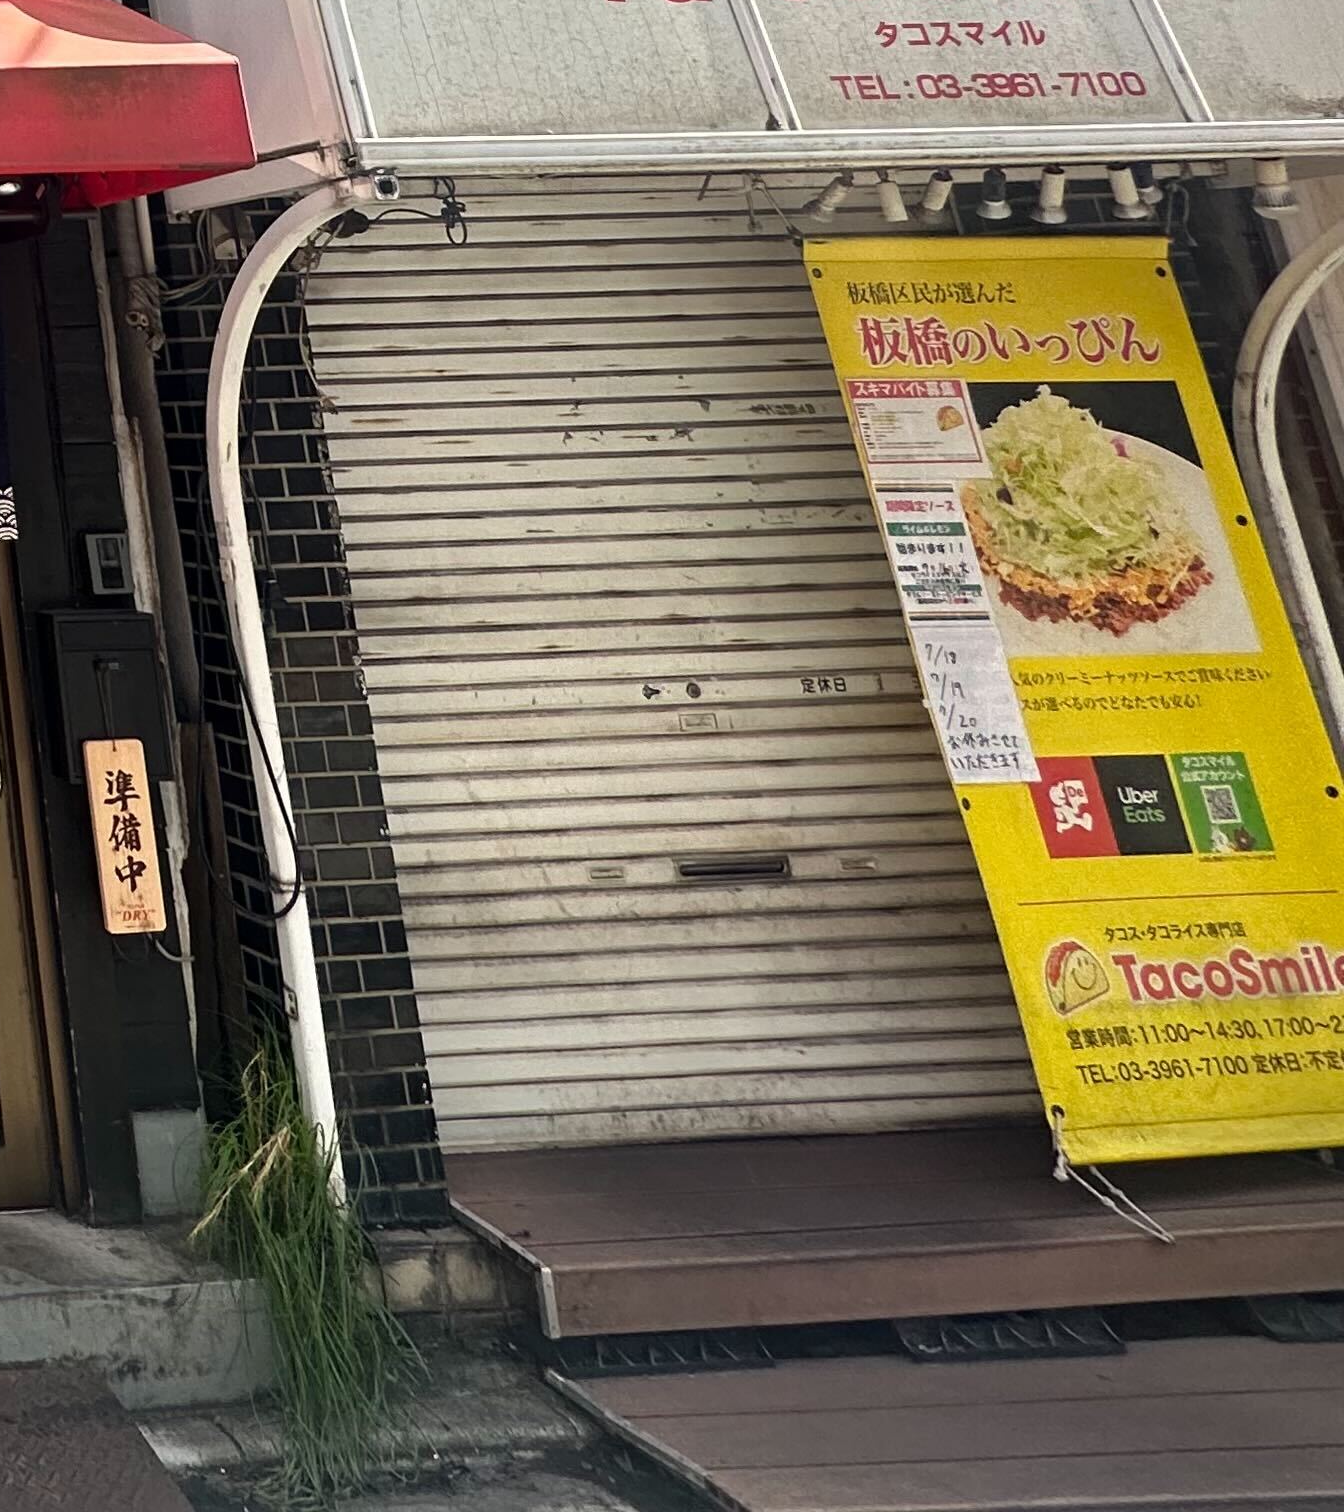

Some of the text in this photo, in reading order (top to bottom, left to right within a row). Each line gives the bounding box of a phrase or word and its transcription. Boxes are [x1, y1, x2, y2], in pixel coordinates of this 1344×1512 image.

[875, 21, 1046, 48] タコスマイル
[847, 281, 1017, 306] 板橋区民が選んだ
[857, 315, 1161, 367] 板橋のいっぴん
[855, 381, 957, 398] スキマバイト募集
[800, 677, 847, 694] 定休日
[1117, 786, 1160, 805] Uber
[1123, 806, 1167, 823] Eats
[104, 769, 148, 893] 準備中
[1076, 1054, 1248, 1086] TEL:03-3961-7100
